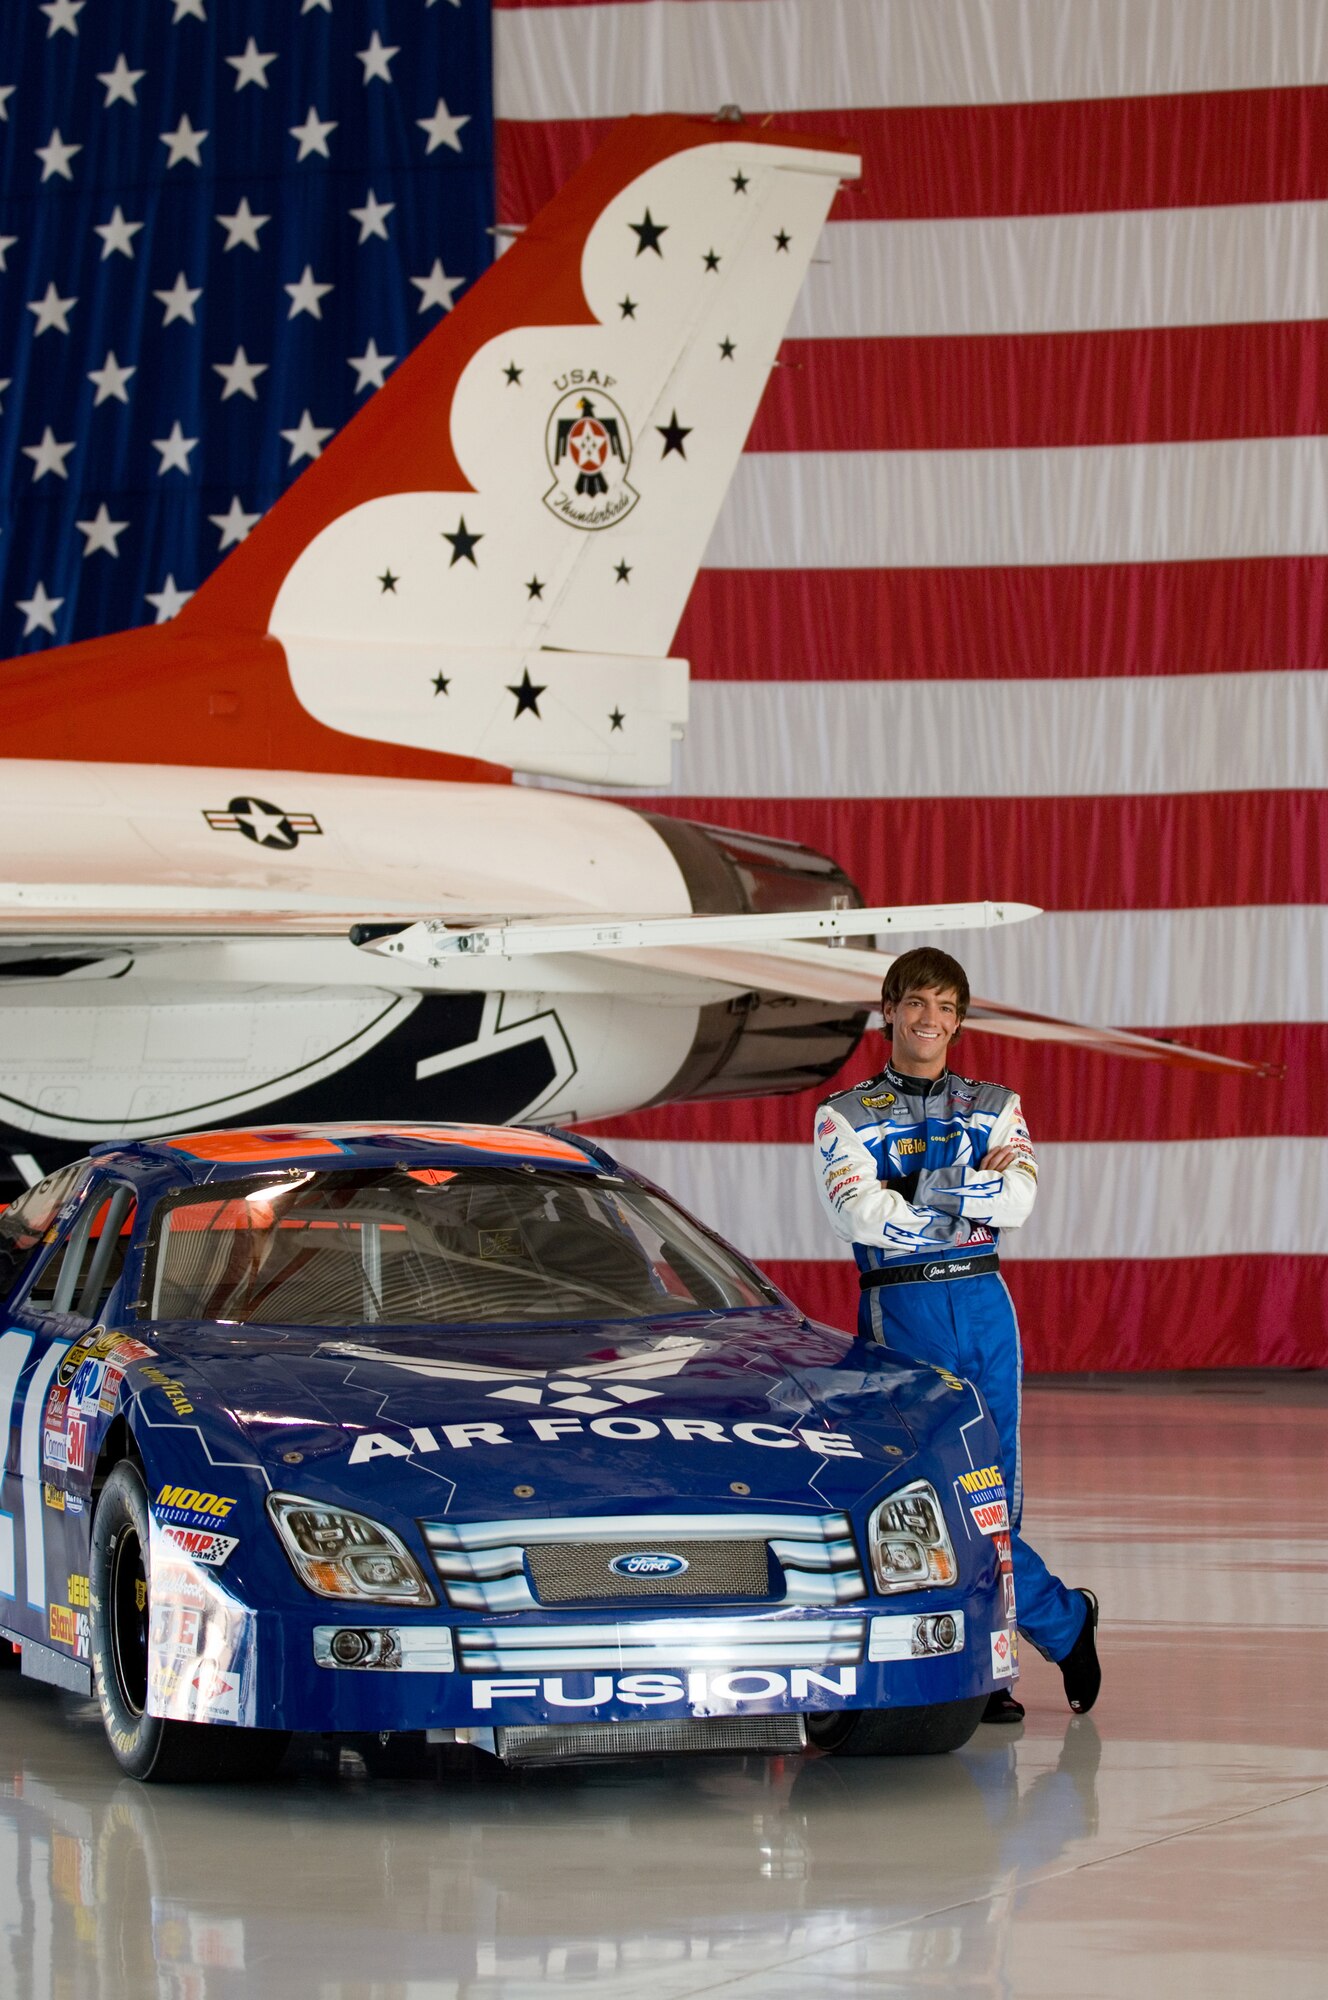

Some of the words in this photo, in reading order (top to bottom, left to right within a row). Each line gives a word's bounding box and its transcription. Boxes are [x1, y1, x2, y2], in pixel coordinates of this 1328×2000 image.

[553, 369, 617, 391] USAF
[554, 492, 629, 523] Thunderbirds
[897, 1138, 927, 1155] Ore-Ida
[928, 1266, 946, 1278] Jon
[948, 1262, 971, 1273] Wood
[138, 1366, 194, 1416] GOODYEAR
[67, 1421, 86, 1467] 3M
[348, 1422, 513, 1465] AIR
[528, 1417, 864, 1459] FORCE
[958, 1465, 1003, 1495] MOOG
[155, 1485, 237, 1517] MOOG
[155, 1507, 189, 1522] CHASSIS
[192, 1513, 223, 1528] PARTS
[974, 1504, 1003, 1528] COMP
[163, 1528, 214, 1554] COMP
[191, 1550, 218, 1561] CAMS
[627, 1556, 671, 1573] Ford
[472, 1667, 857, 1709] FUSION
